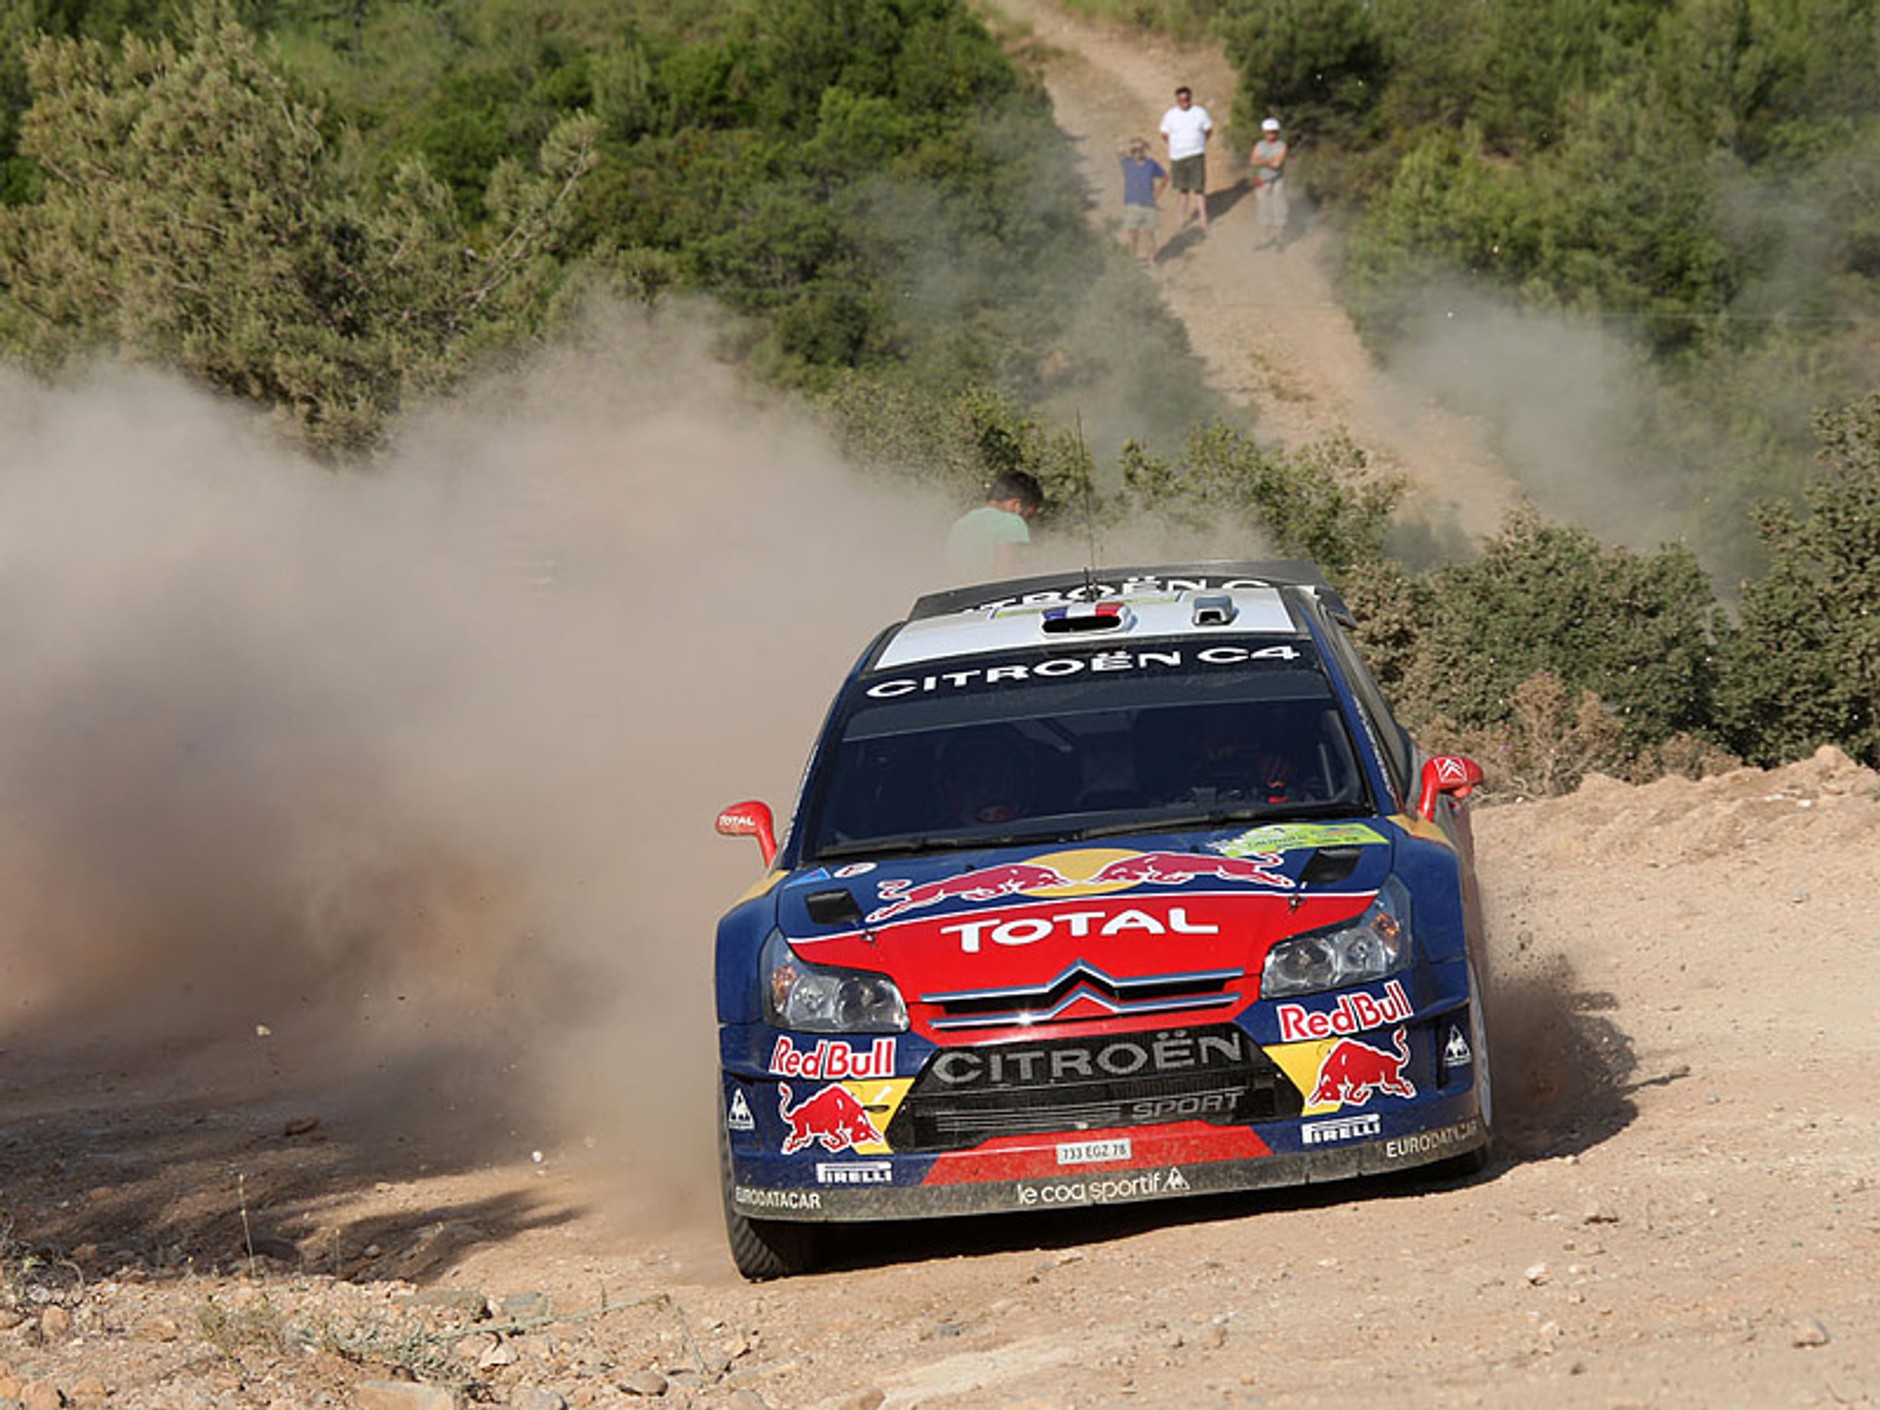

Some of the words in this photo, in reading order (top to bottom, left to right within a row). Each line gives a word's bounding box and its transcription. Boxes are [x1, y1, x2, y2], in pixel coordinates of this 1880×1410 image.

[866, 649, 1182, 698] CITROËN
[1198, 645, 1301, 664] C4
[719, 815, 755, 826] TOTAL
[940, 907, 1219, 953] TOTAL
[1277, 996, 1356, 1041] Red
[1352, 979, 1414, 1029] Bull
[768, 1035, 825, 1077] Red
[825, 1037, 896, 1077] Bull
[931, 1029, 1243, 1083] CITROËN
[1131, 1090, 1245, 1121] SPORT
[1302, 1114, 1381, 1144] PIRELLI
[815, 1162, 893, 1183] PIRELLI
[1017, 1183, 1037, 1205] le
[1088, 1172, 1161, 1201] sportif
